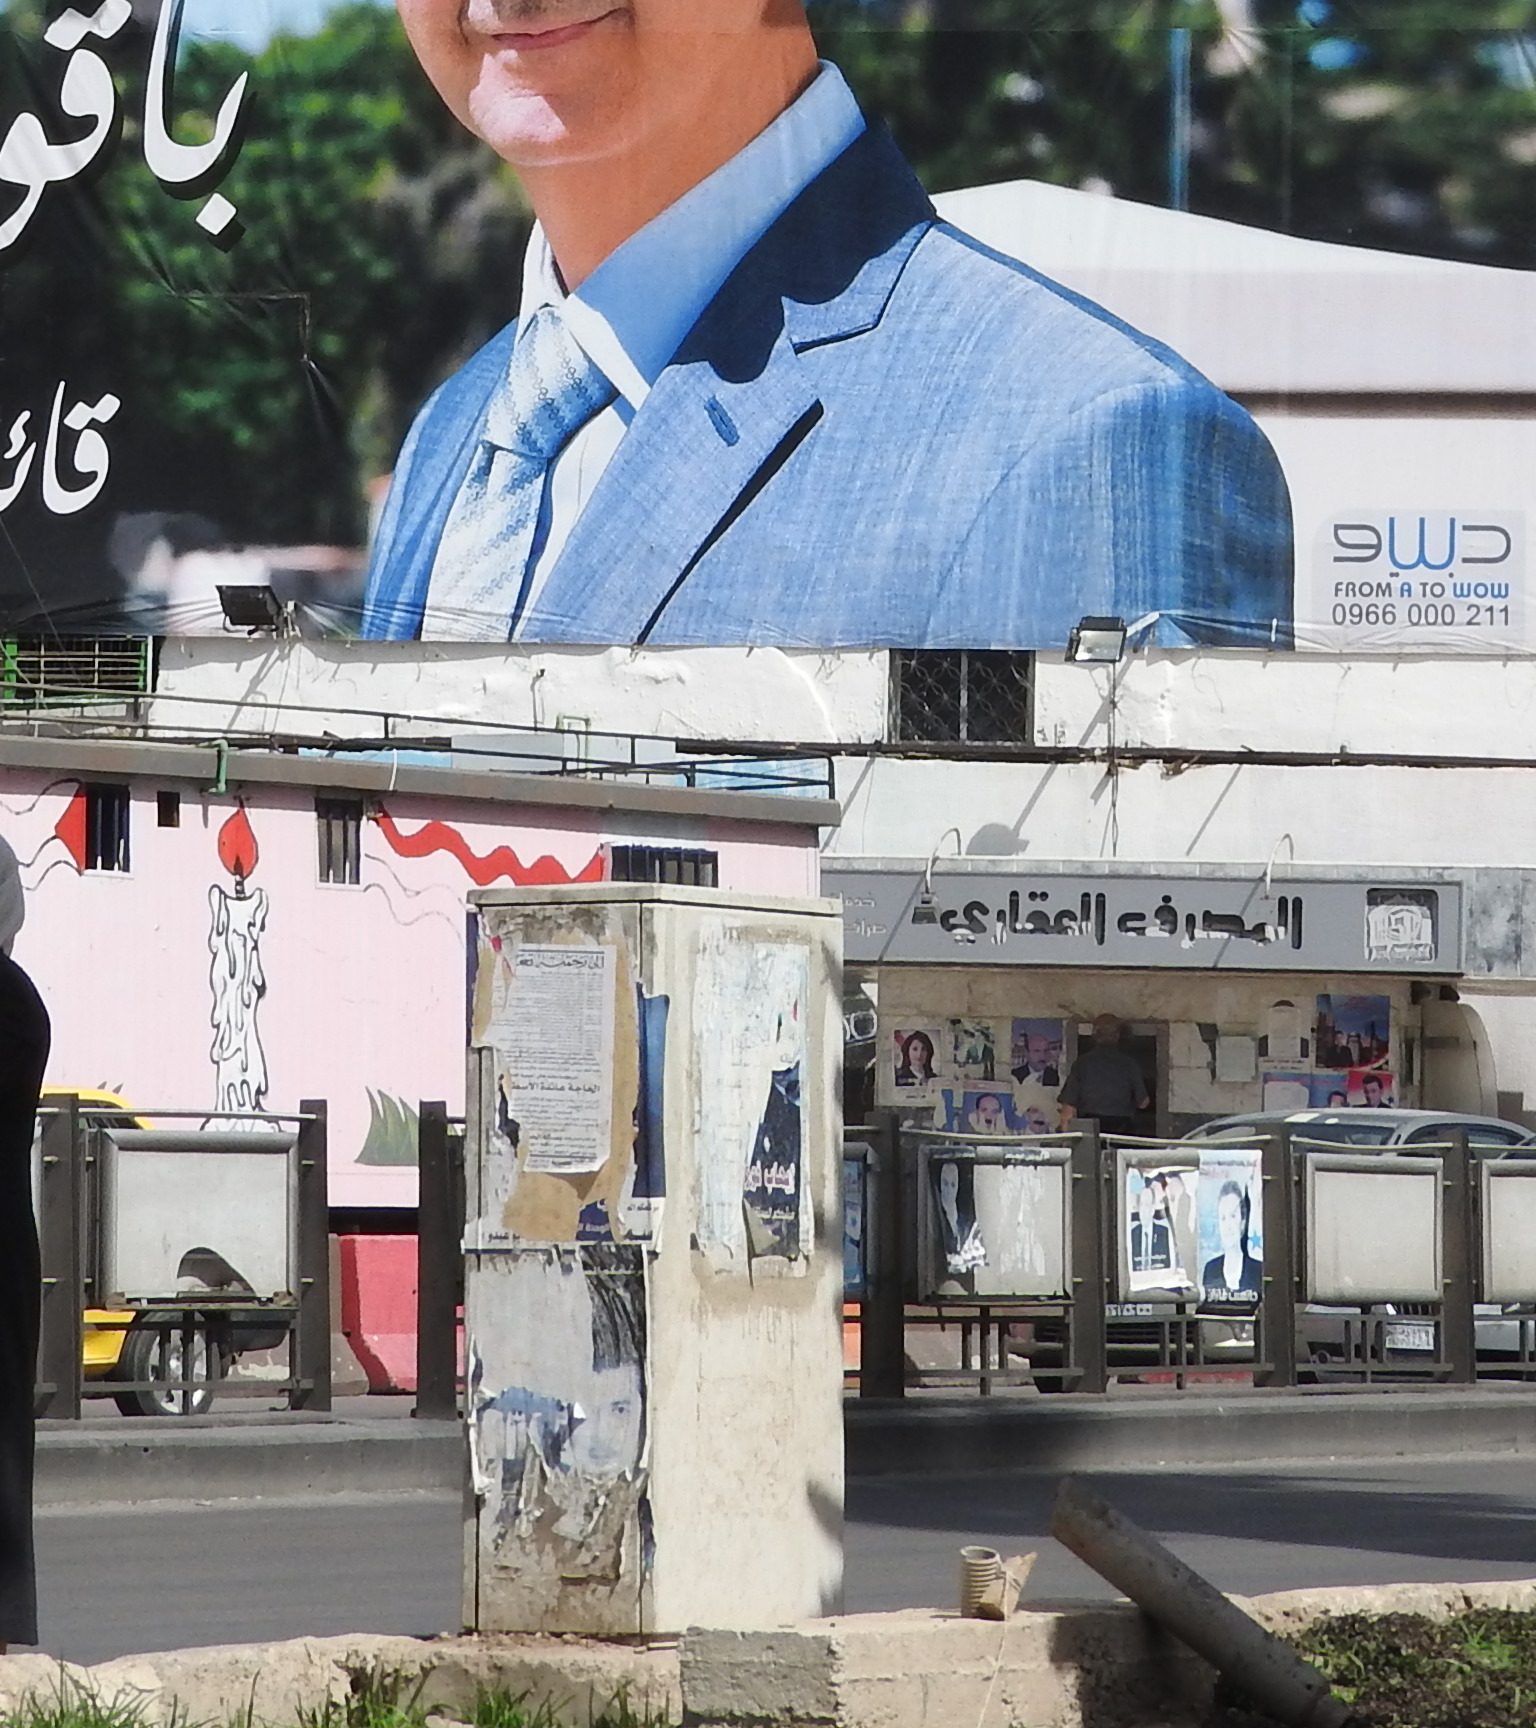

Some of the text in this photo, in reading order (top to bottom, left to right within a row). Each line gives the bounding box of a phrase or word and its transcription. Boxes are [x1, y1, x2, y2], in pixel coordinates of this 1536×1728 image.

[1334, 582, 1392, 598] FROM
[1400, 582, 1412, 598] A
[1419, 582, 1446, 598] TO
[1332, 602, 1509, 626] 0966 000 211
[939, 889, 1303, 950] المصرف العقاري
